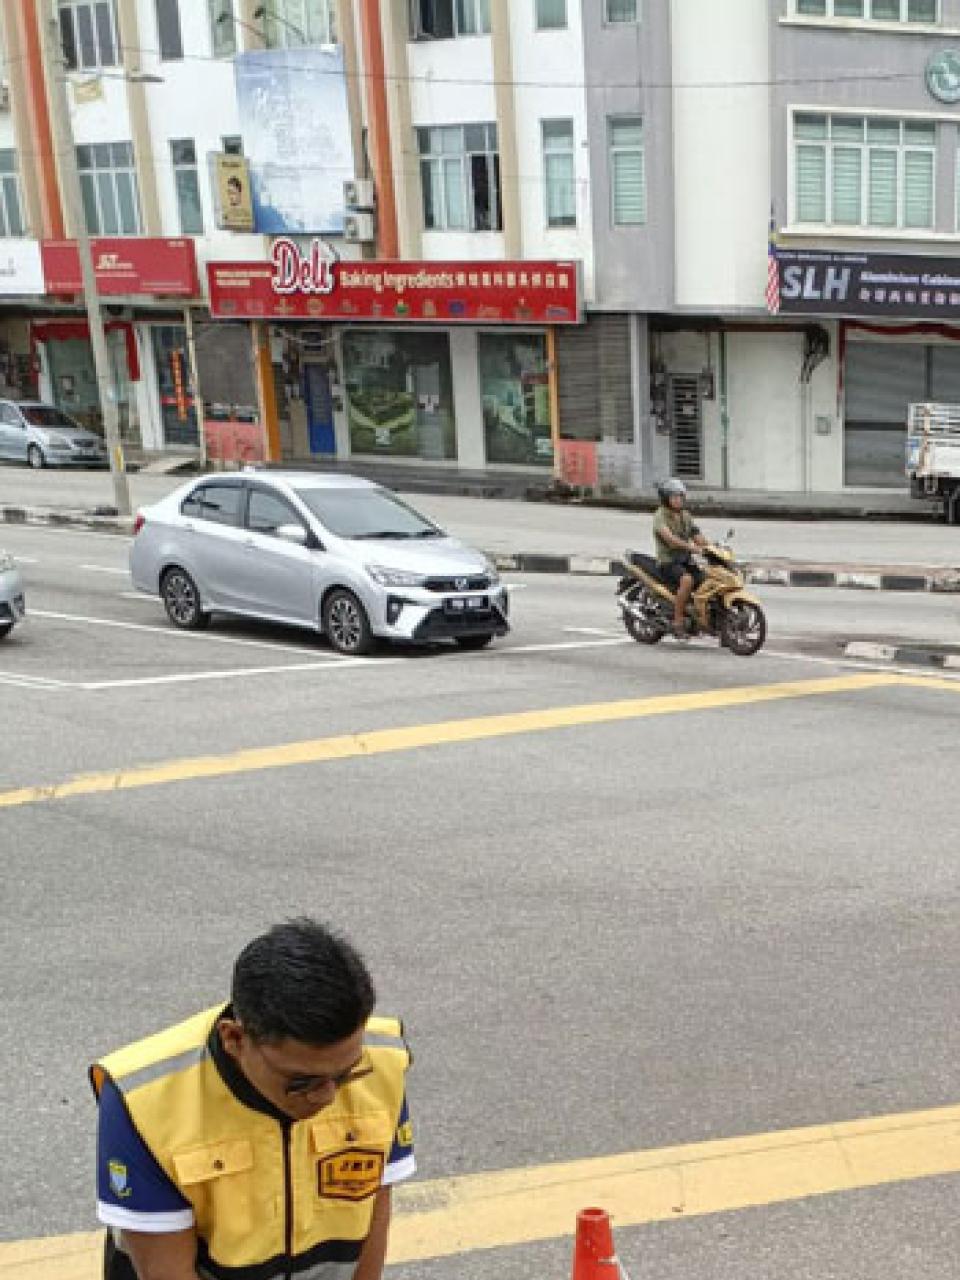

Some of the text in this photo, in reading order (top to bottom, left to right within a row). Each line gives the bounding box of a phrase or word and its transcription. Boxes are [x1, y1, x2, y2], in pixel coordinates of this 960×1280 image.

[272, 238, 335, 294] Deli
[339, 270, 382, 293] Baking
[782, 265, 851, 301] SLH
